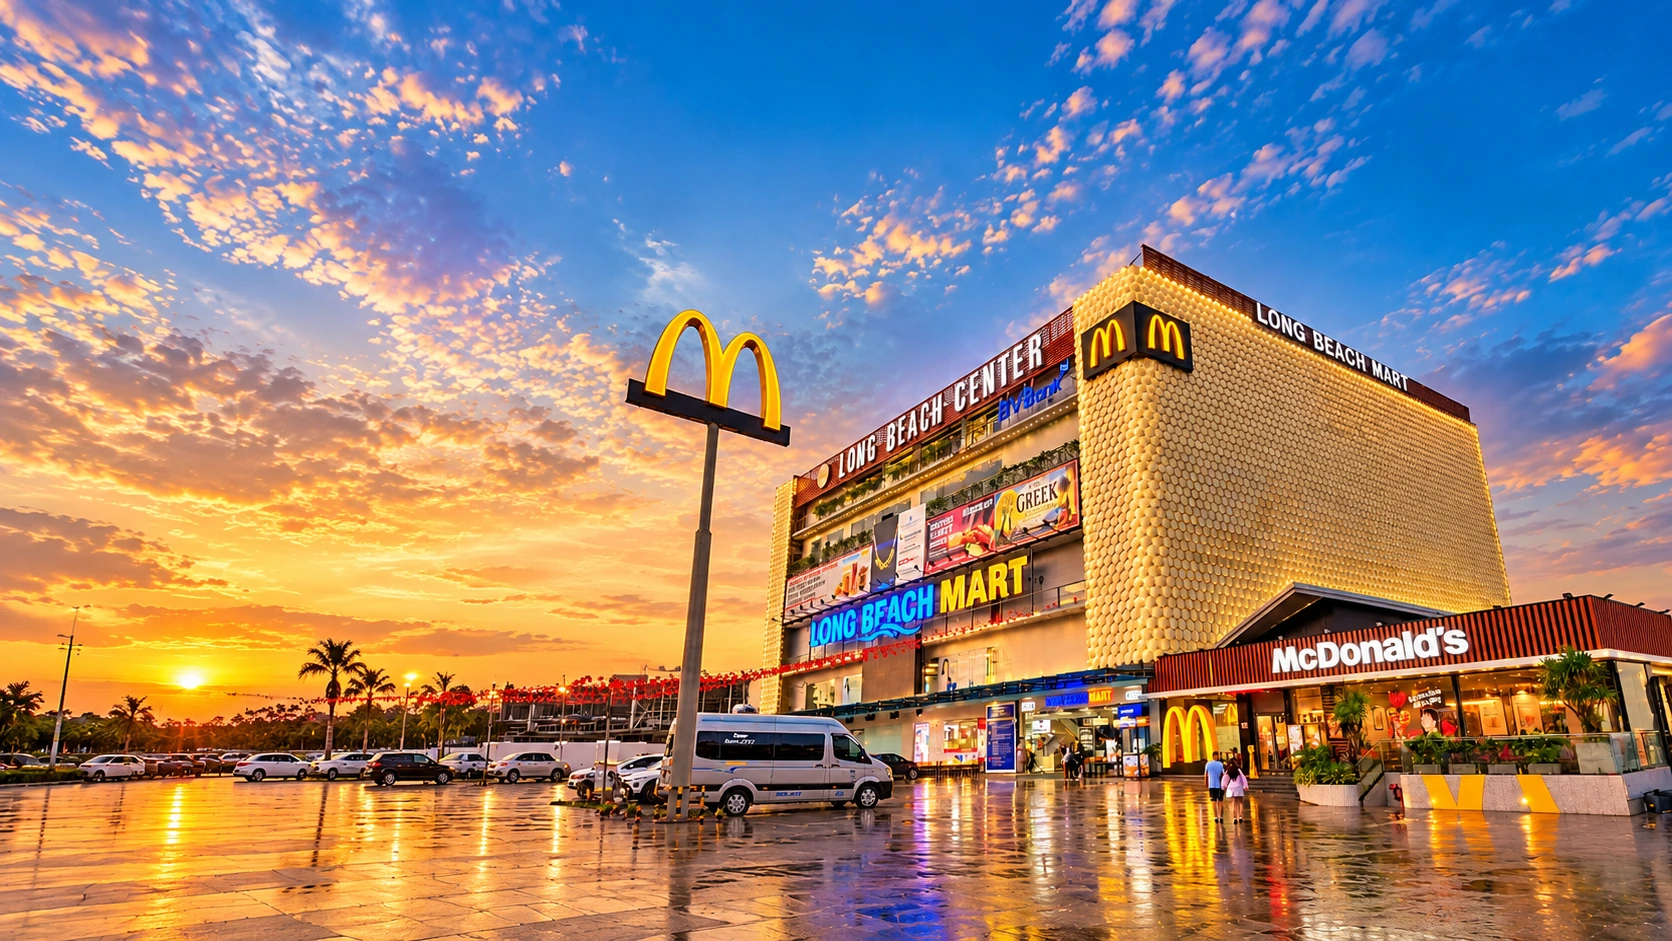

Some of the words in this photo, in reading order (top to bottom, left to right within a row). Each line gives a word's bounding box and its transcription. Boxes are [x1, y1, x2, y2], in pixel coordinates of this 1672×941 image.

[1256, 302, 1306, 343] LONG
[1312, 330, 1367, 372] BEACH
[1371, 359, 1409, 392] MART
[838, 434, 876, 479] LONG
[886, 393, 943, 452] BEACH
[954, 332, 1043, 412] CENTER
[1016, 481, 1058, 513] GREEK
[810, 609, 857, 648] LONG
[940, 555, 1027, 614] MART
[1272, 626, 1469, 673] McDonald's
